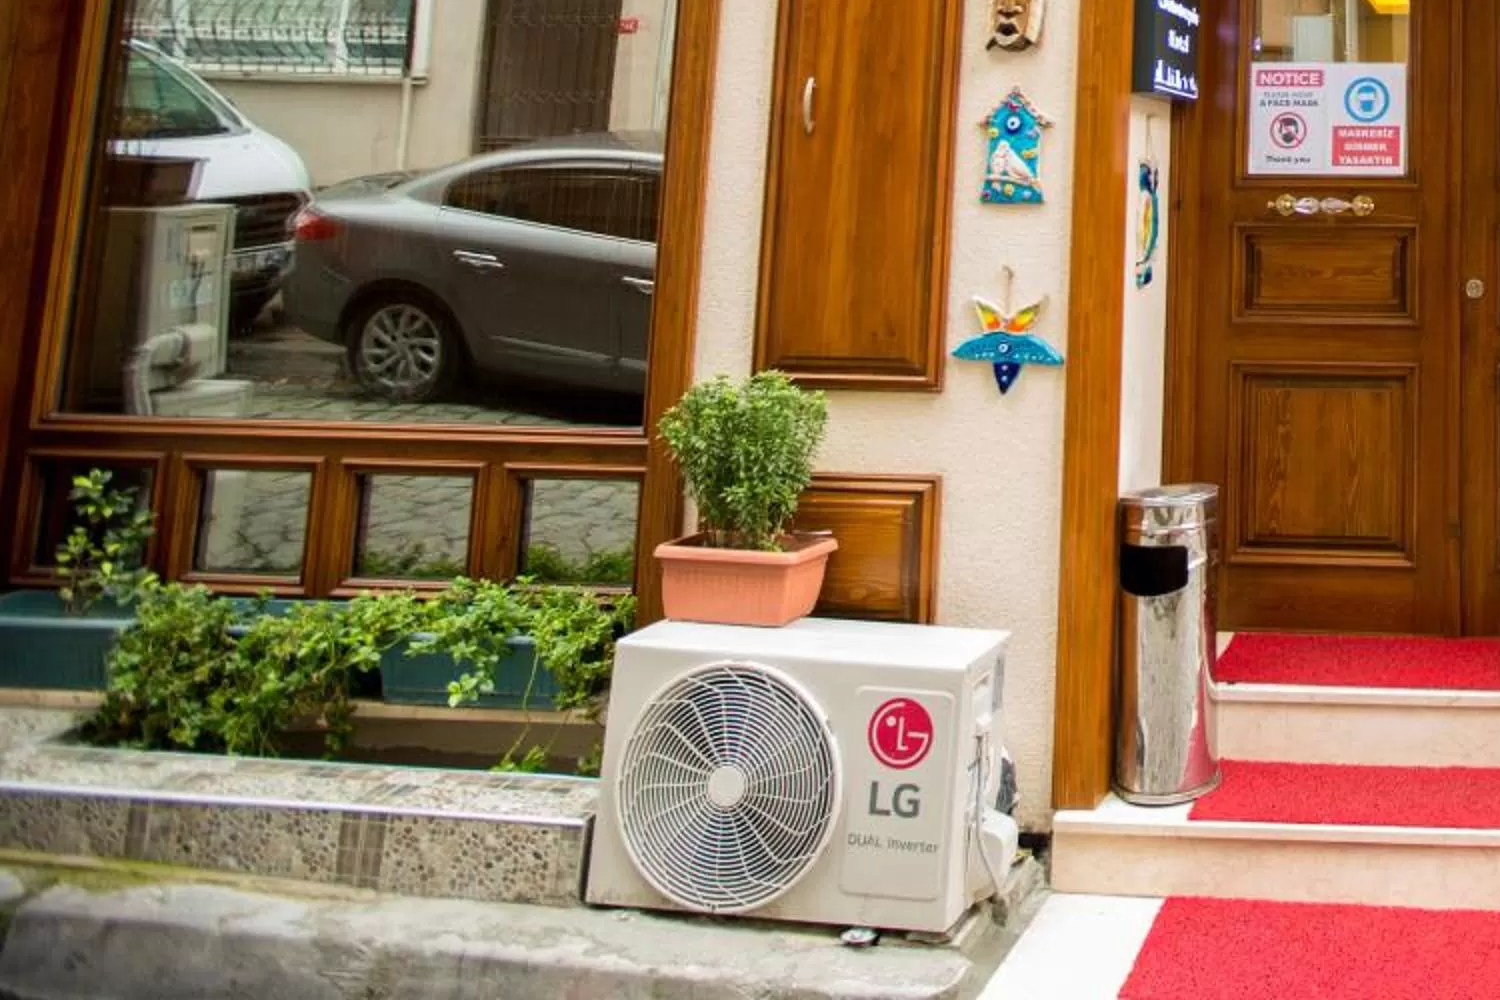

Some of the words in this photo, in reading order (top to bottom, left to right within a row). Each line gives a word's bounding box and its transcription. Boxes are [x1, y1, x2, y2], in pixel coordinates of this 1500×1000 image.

[1260, 71, 1321, 86] NOTICE
[866, 697, 935, 770] LG
[868, 780, 921, 819] LG
[847, 832, 883, 848] DUAL
[887, 838, 940, 854] inverter
